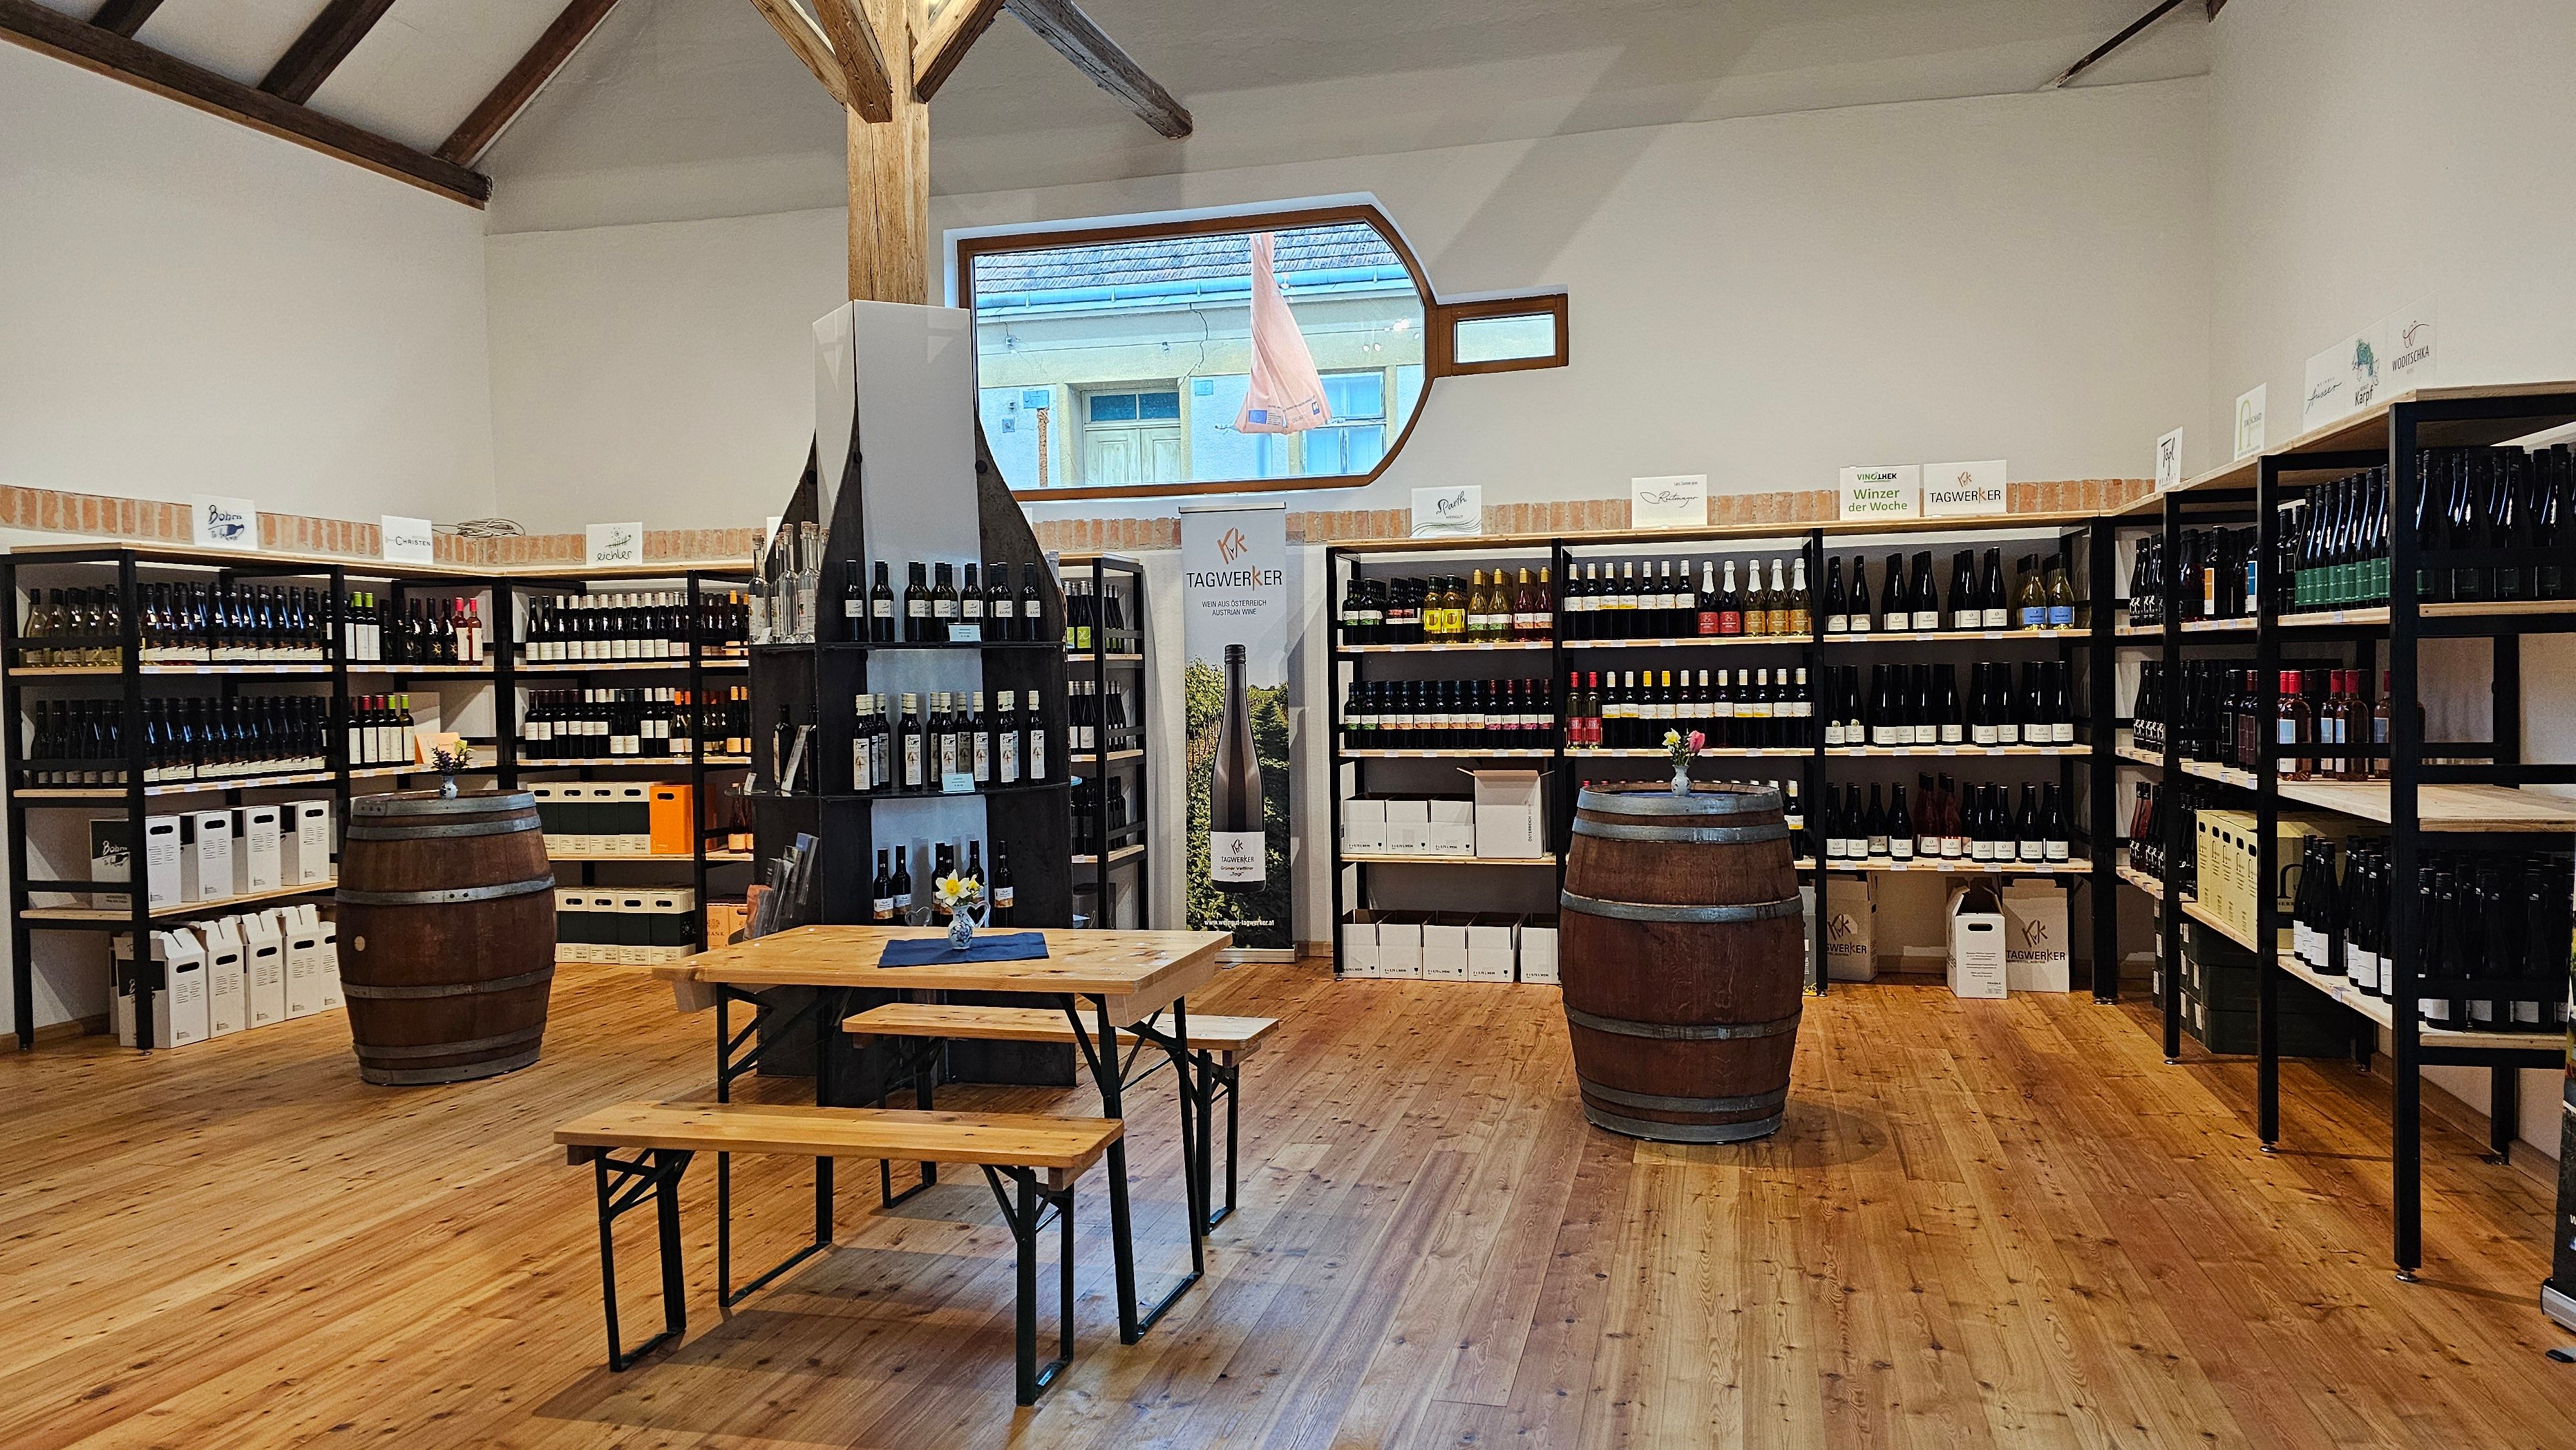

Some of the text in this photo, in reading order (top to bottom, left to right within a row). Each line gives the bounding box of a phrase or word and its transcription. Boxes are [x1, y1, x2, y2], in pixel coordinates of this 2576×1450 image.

[2392, 344, 2430, 372] WODITSCHKA
[2355, 385, 2374, 406] Karpf
[1853, 488, 1900, 500] Winzer
[1848, 501, 1908, 512] der Woche
[596, 548, 632, 562] eichler
[1204, 918, 1274, 927] www.weingut-tagwerker.at
[2006, 948, 2065, 962] TAGWERKER
